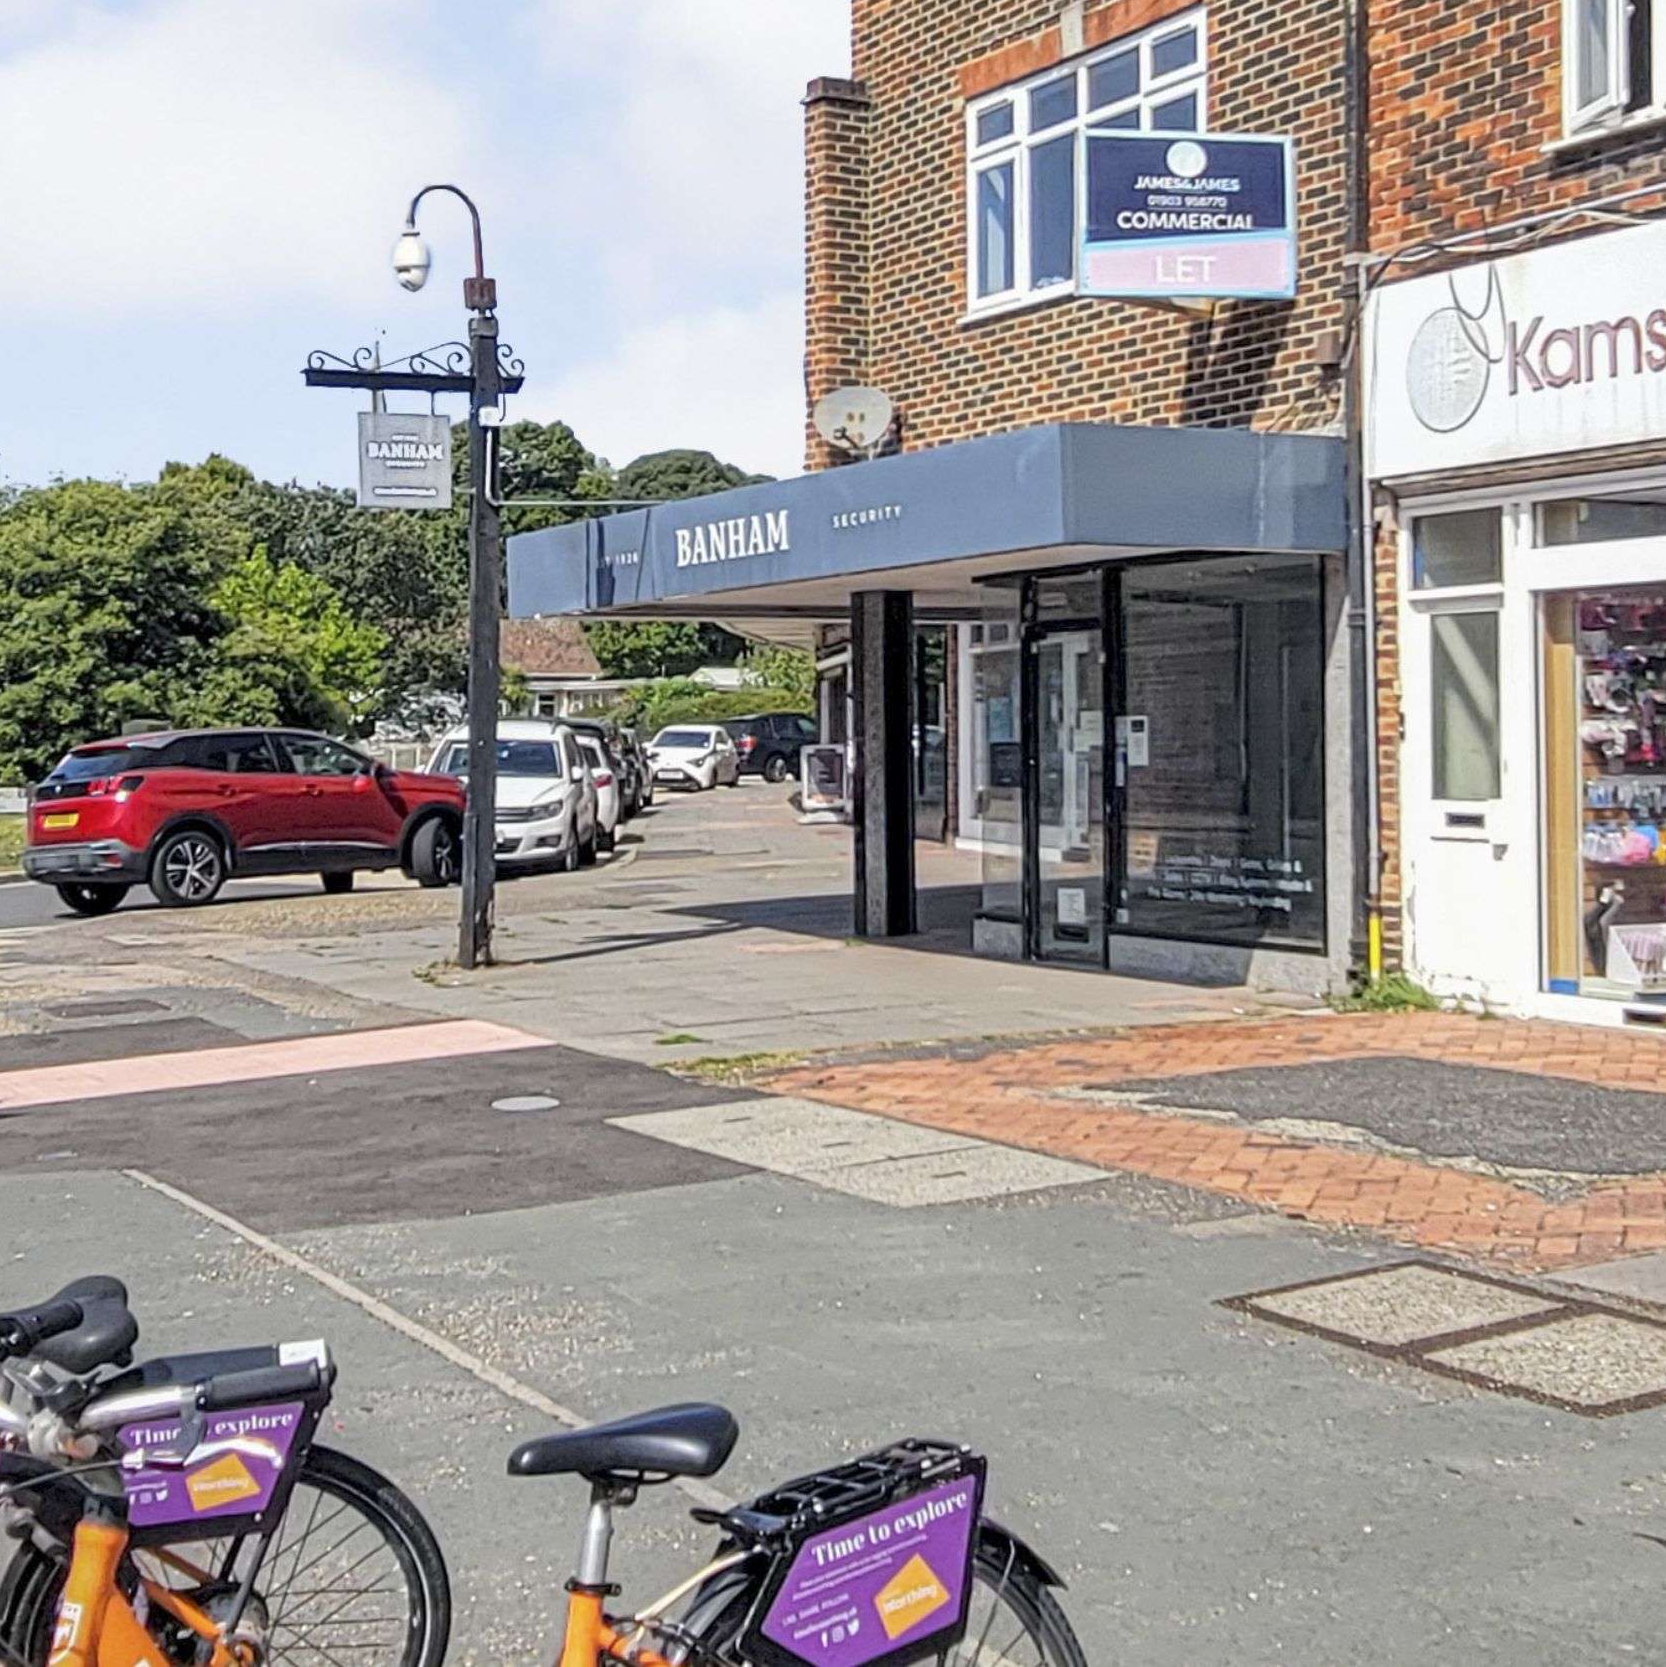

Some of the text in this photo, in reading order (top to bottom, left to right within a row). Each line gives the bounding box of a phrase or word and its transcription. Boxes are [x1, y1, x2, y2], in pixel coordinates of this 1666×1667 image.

[1154, 254, 1218, 284] LET
[368, 441, 443, 461] BANHAM
[675, 509, 791, 568] BANHAM
[832, 505, 903, 530] SECURITY
[214, 1413, 294, 1434] explore
[811, 1492, 968, 1566] Time to explore
